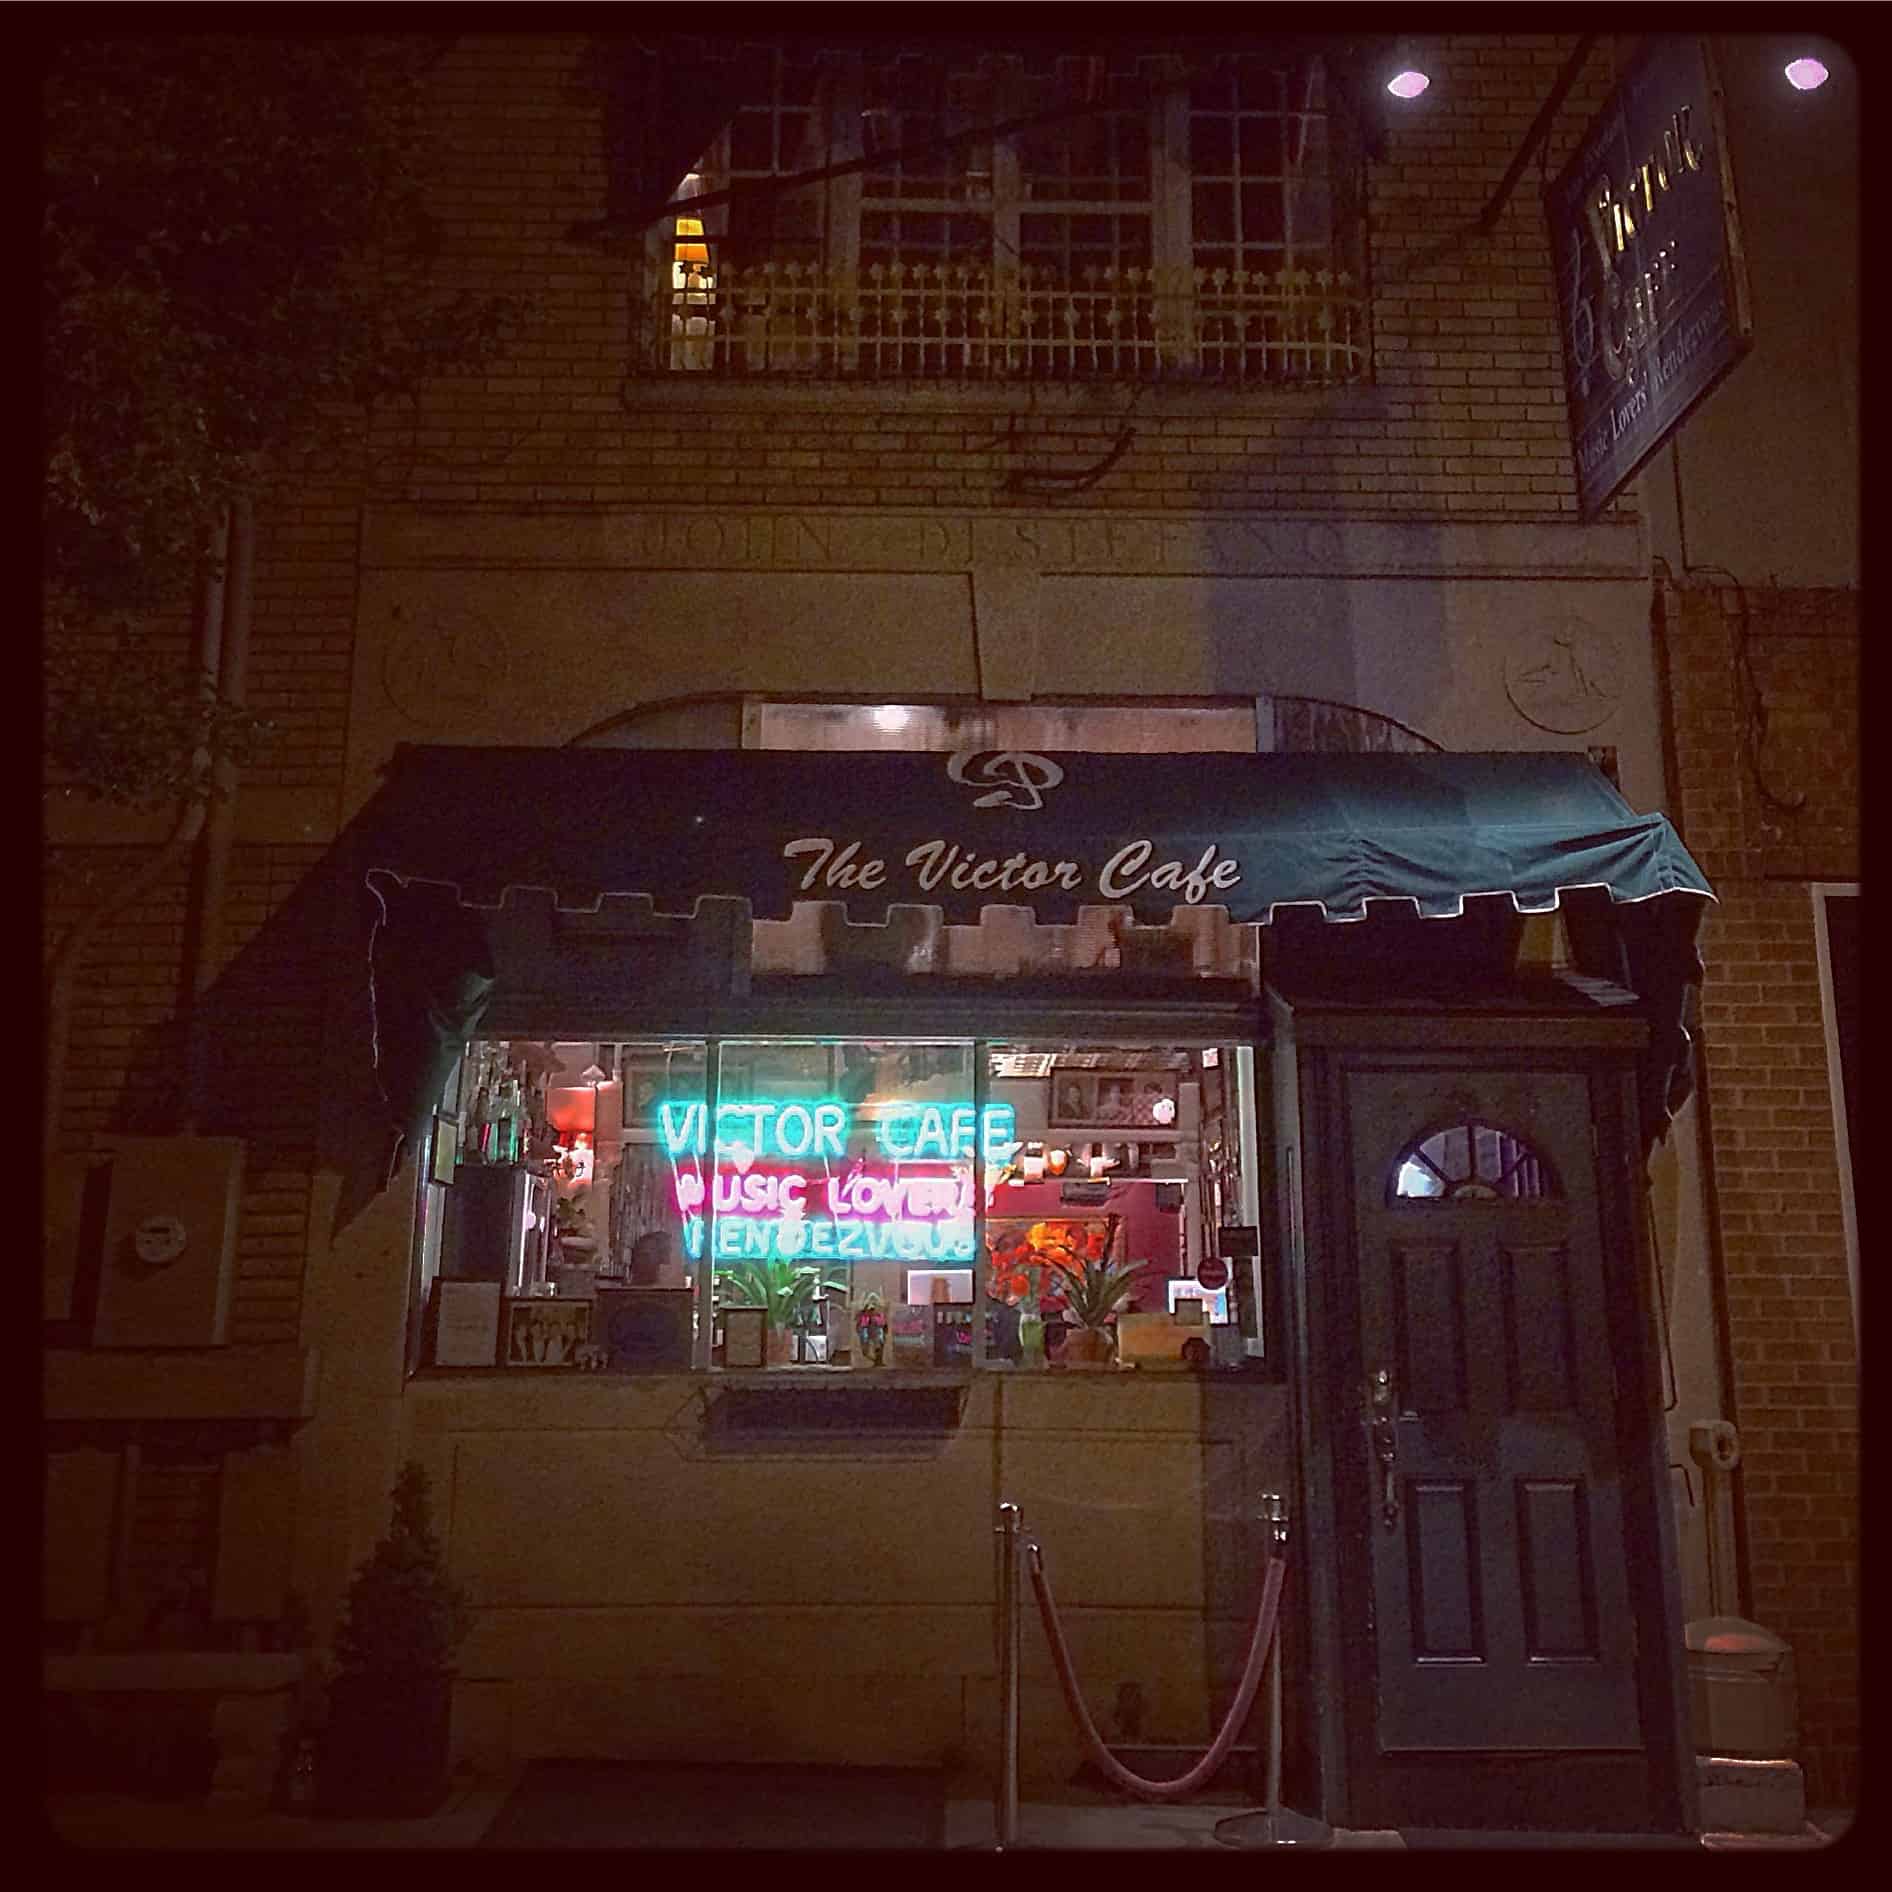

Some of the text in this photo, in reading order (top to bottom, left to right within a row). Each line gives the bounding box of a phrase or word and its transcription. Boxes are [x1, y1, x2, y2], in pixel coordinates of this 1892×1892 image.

[783, 837, 1242, 905] The Victor Cafe
[660, 1102, 1016, 1156] VICTOR CAFE
